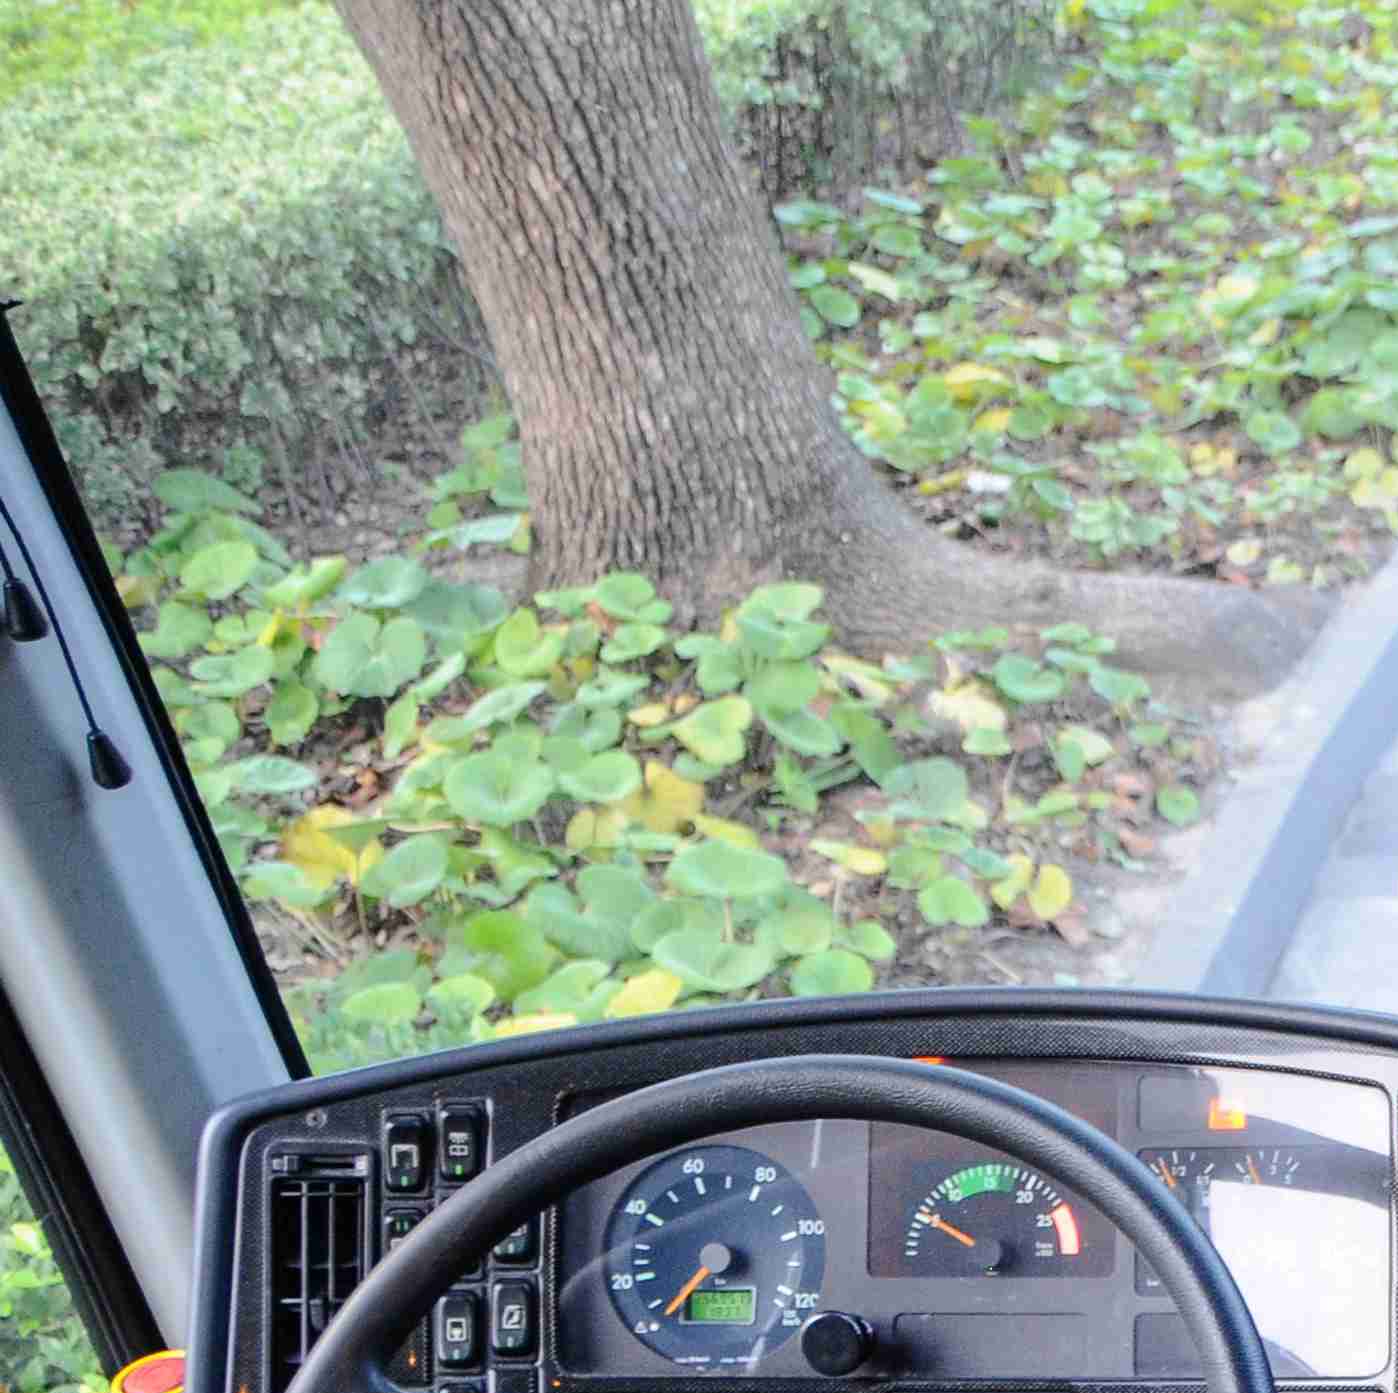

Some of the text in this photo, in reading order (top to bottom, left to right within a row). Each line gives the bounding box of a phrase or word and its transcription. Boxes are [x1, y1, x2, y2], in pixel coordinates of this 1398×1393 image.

[682, 1158, 704, 1174] 60
[755, 1167, 776, 1182] 80
[1016, 1190, 1034, 1204] 20
[624, 1199, 646, 1214] 40
[797, 1220, 825, 1235] 100
[1035, 1213, 1053, 1228] 25
[611, 1274, 633, 1290] 20
